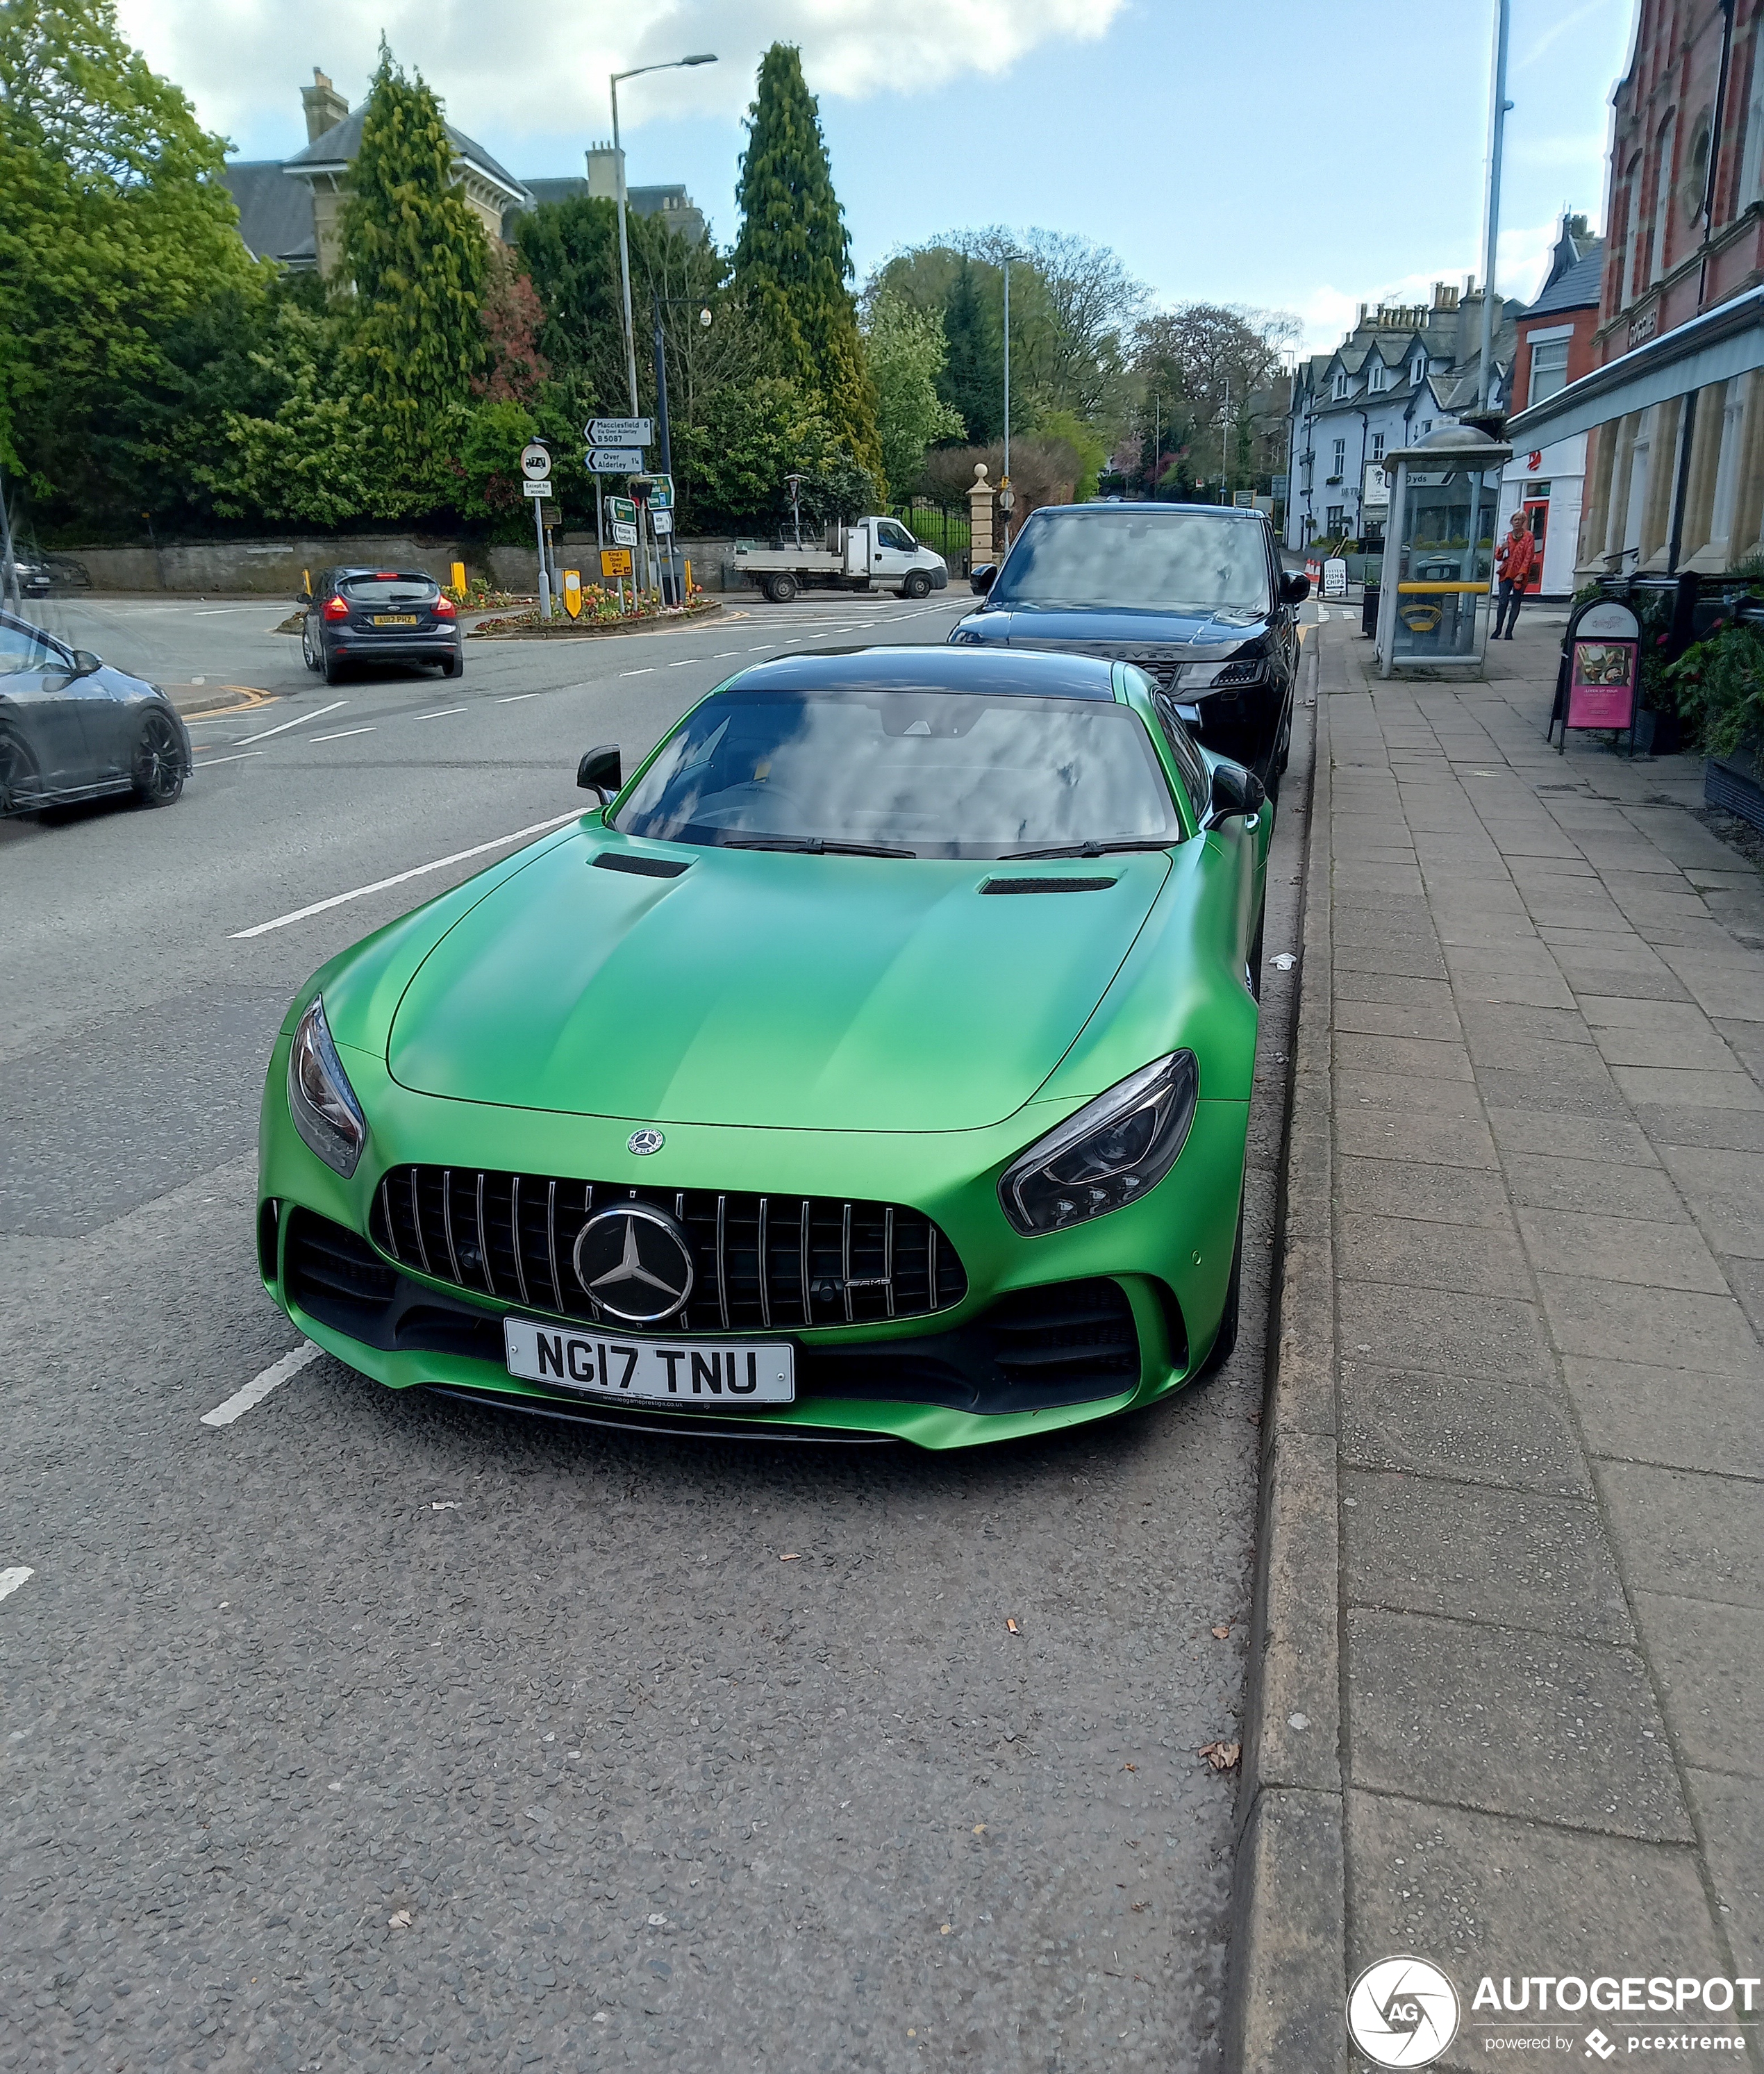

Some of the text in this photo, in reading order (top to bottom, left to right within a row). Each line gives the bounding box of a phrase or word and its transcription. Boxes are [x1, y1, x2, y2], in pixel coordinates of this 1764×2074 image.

[1413, 475, 1427, 483] yds
[1101, 651, 1174, 659] ROVER
[536, 1331, 757, 1395] NG17 TNU
